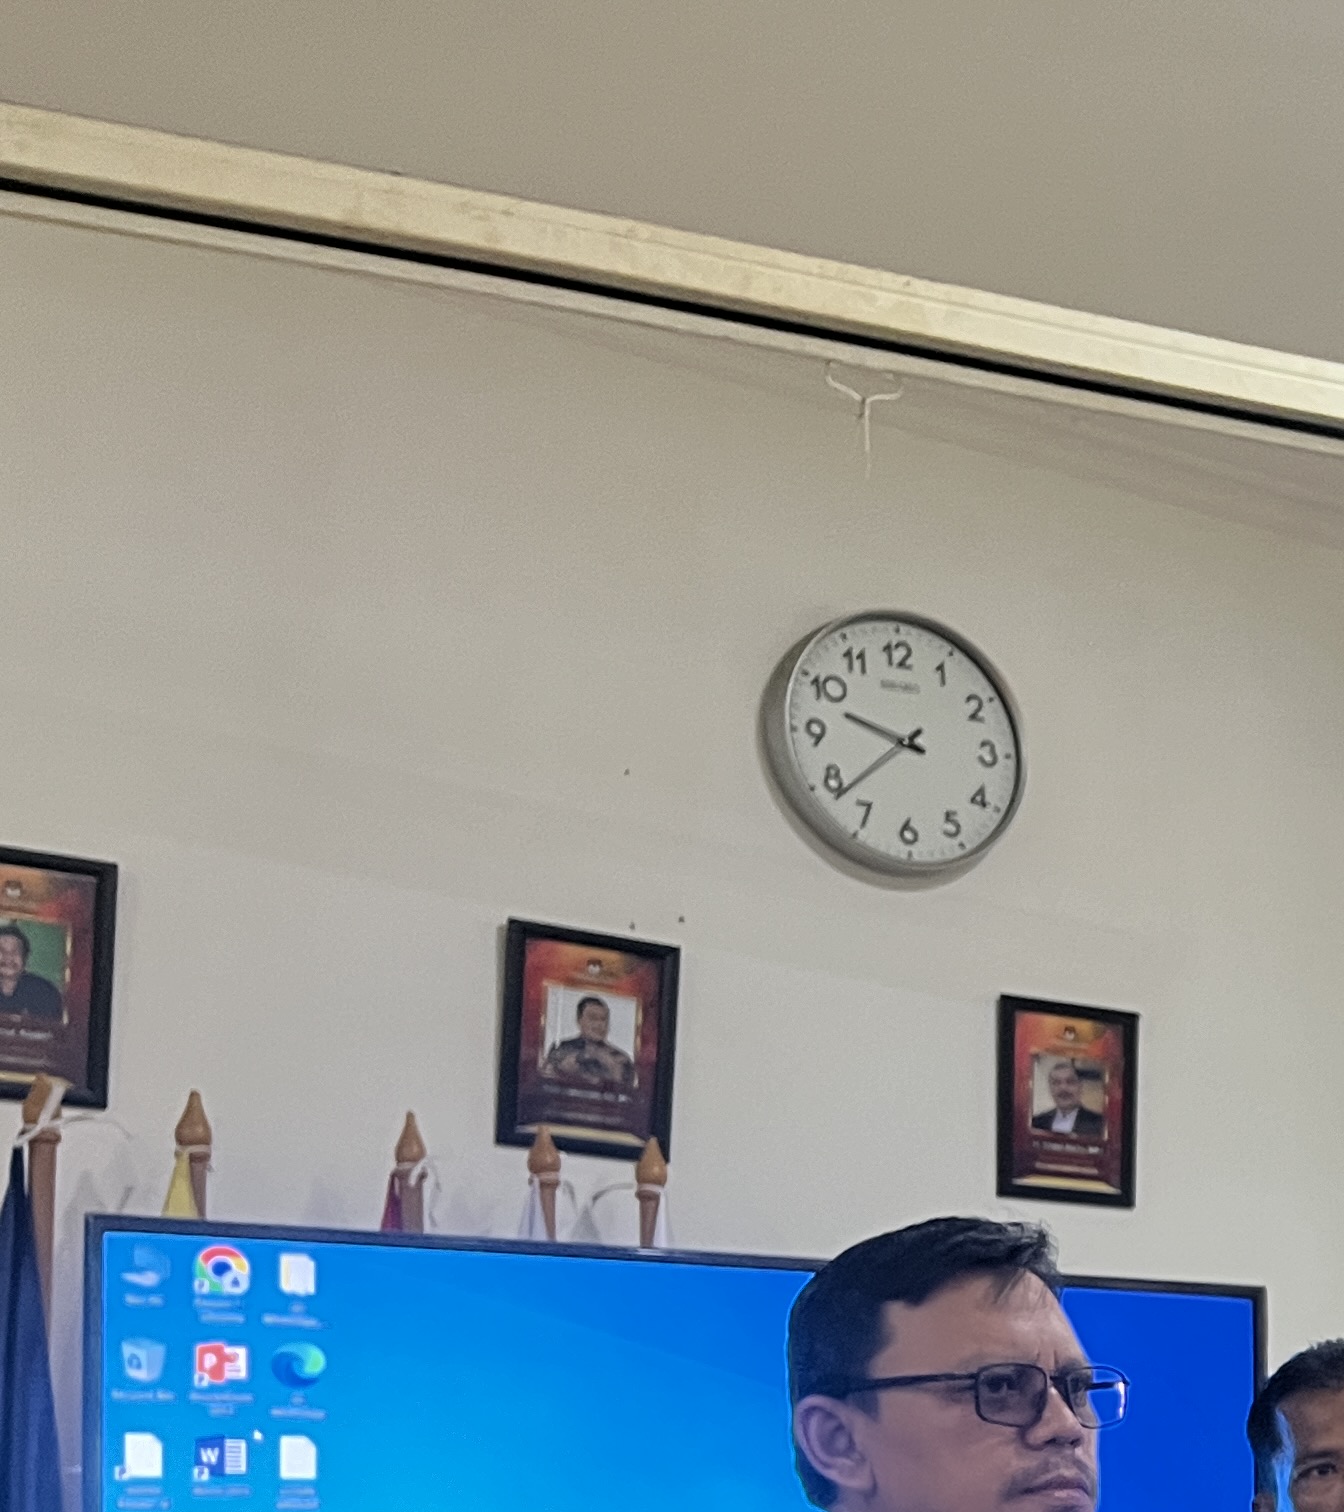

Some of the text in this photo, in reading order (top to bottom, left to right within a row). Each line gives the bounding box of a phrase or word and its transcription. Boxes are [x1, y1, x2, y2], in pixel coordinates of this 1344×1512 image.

[843, 646, 867, 675] 11
[883, 640, 913, 670] 12
[935, 661, 946, 687] 1
[810, 675, 848, 703] 10
[965, 694, 985, 723] 2
[805, 717, 827, 747] 9
[978, 739, 998, 768] 3
[823, 763, 844, 794] 8
[970, 783, 989, 808] 4
[856, 798, 874, 829] 7
[943, 810, 961, 838] 5
[900, 817, 919, 845] 6
